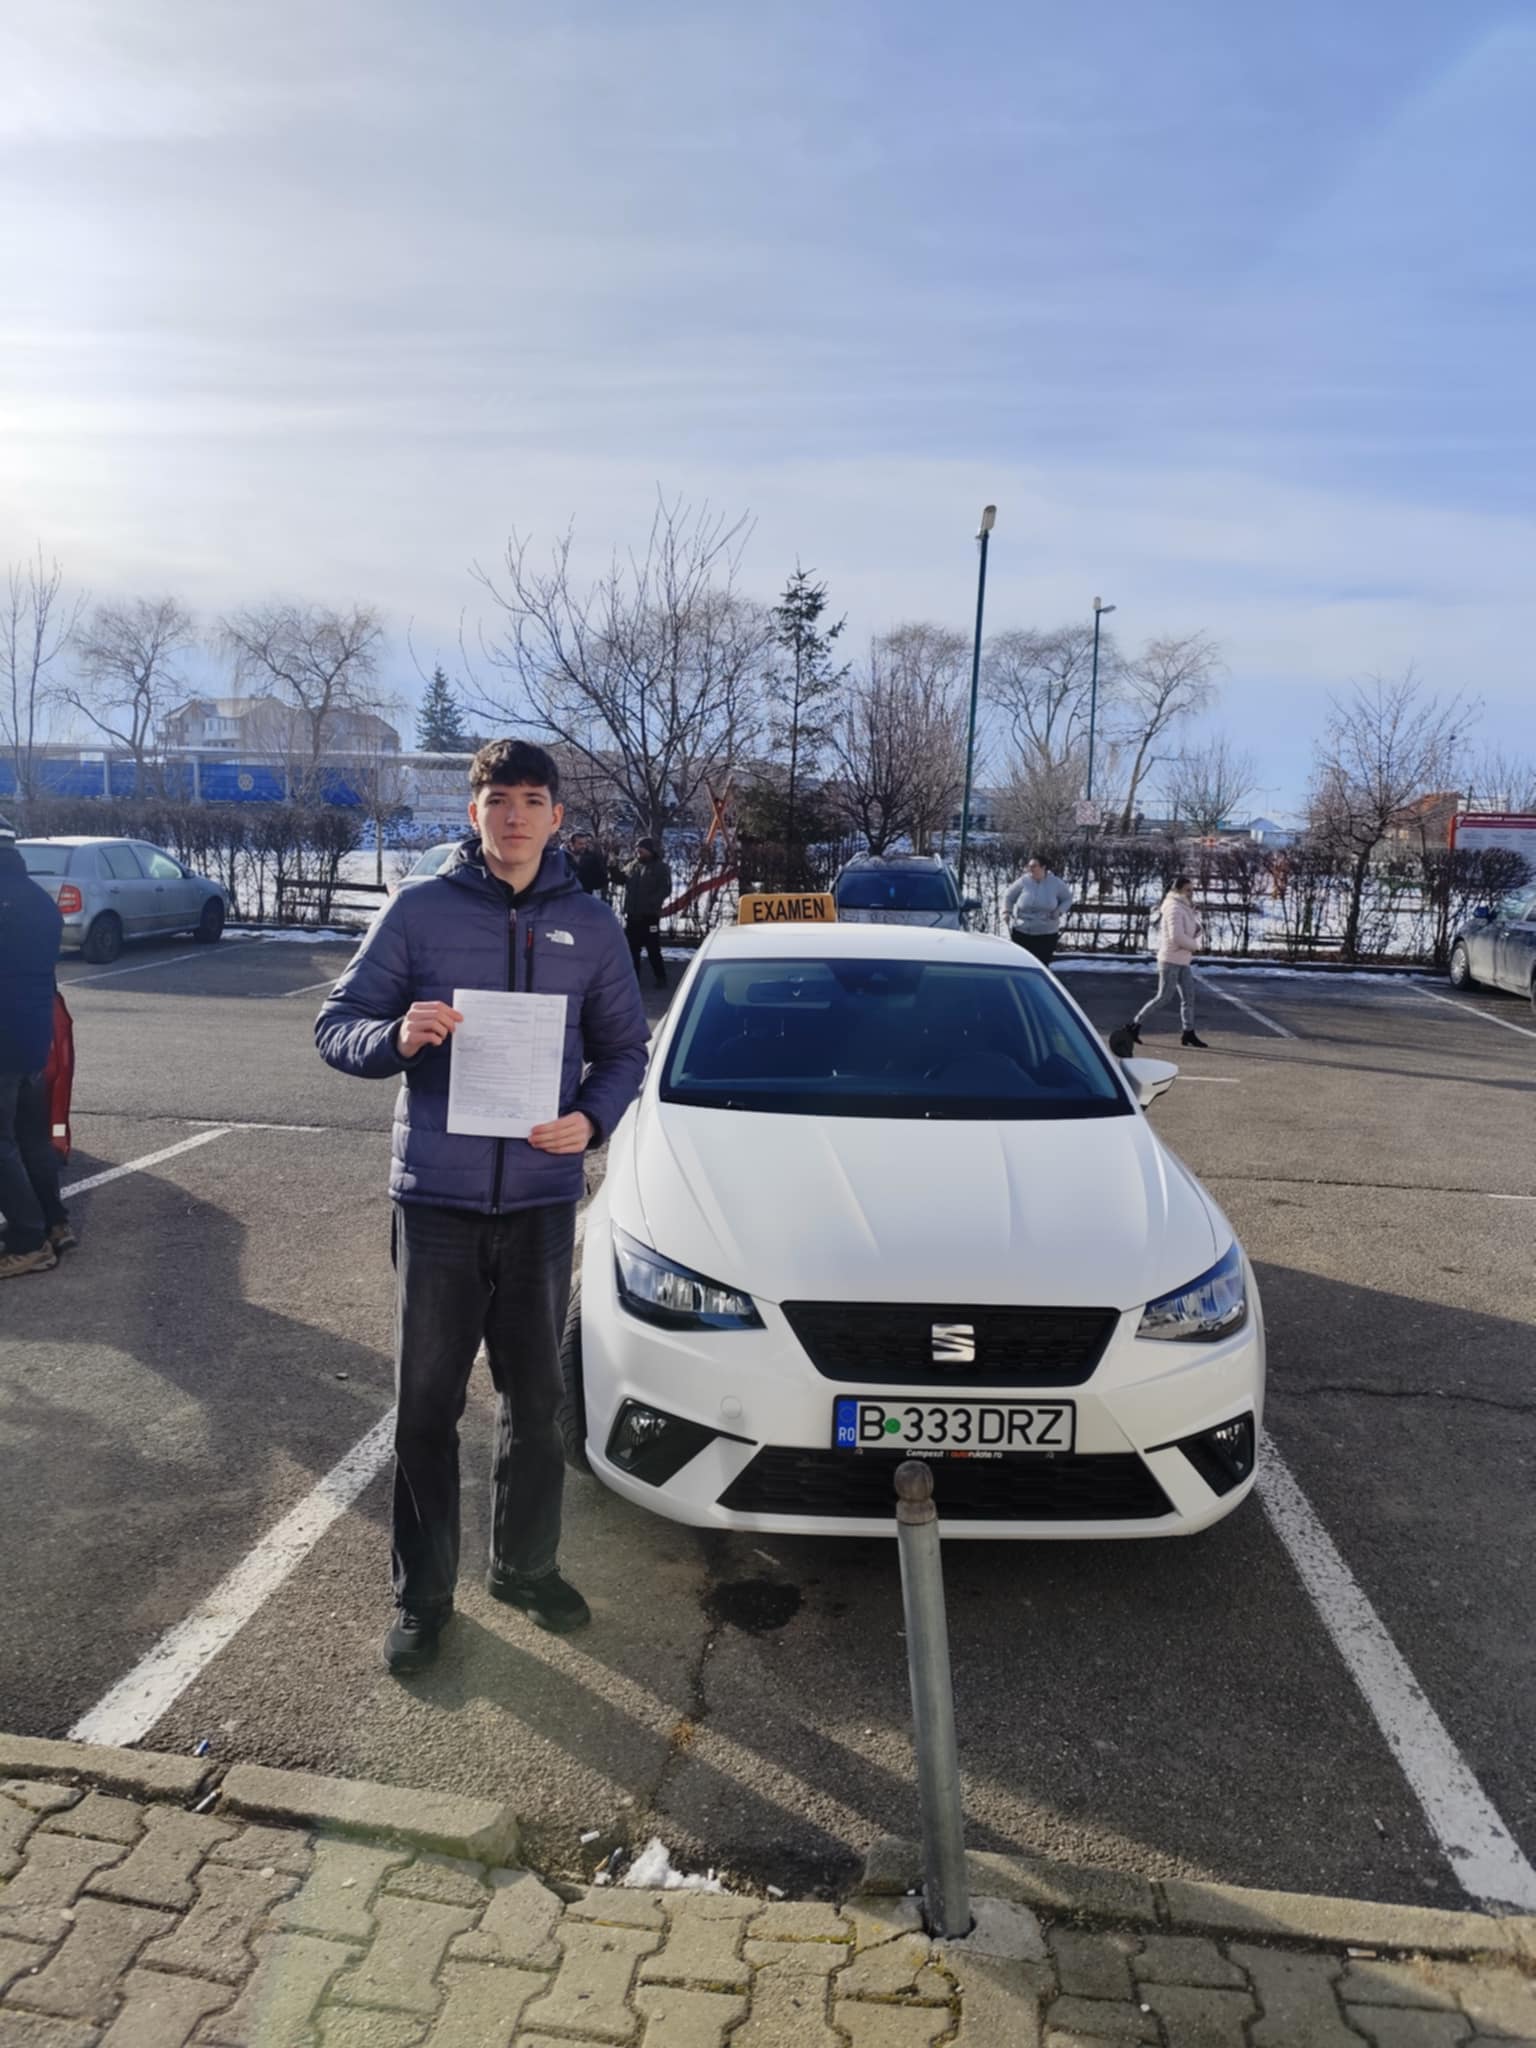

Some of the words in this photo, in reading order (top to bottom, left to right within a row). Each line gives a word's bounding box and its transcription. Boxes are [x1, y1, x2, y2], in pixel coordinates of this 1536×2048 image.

[753, 898, 825, 922] EXAMEN
[839, 1426, 855, 1441] RO
[859, 1404, 886, 1441] B
